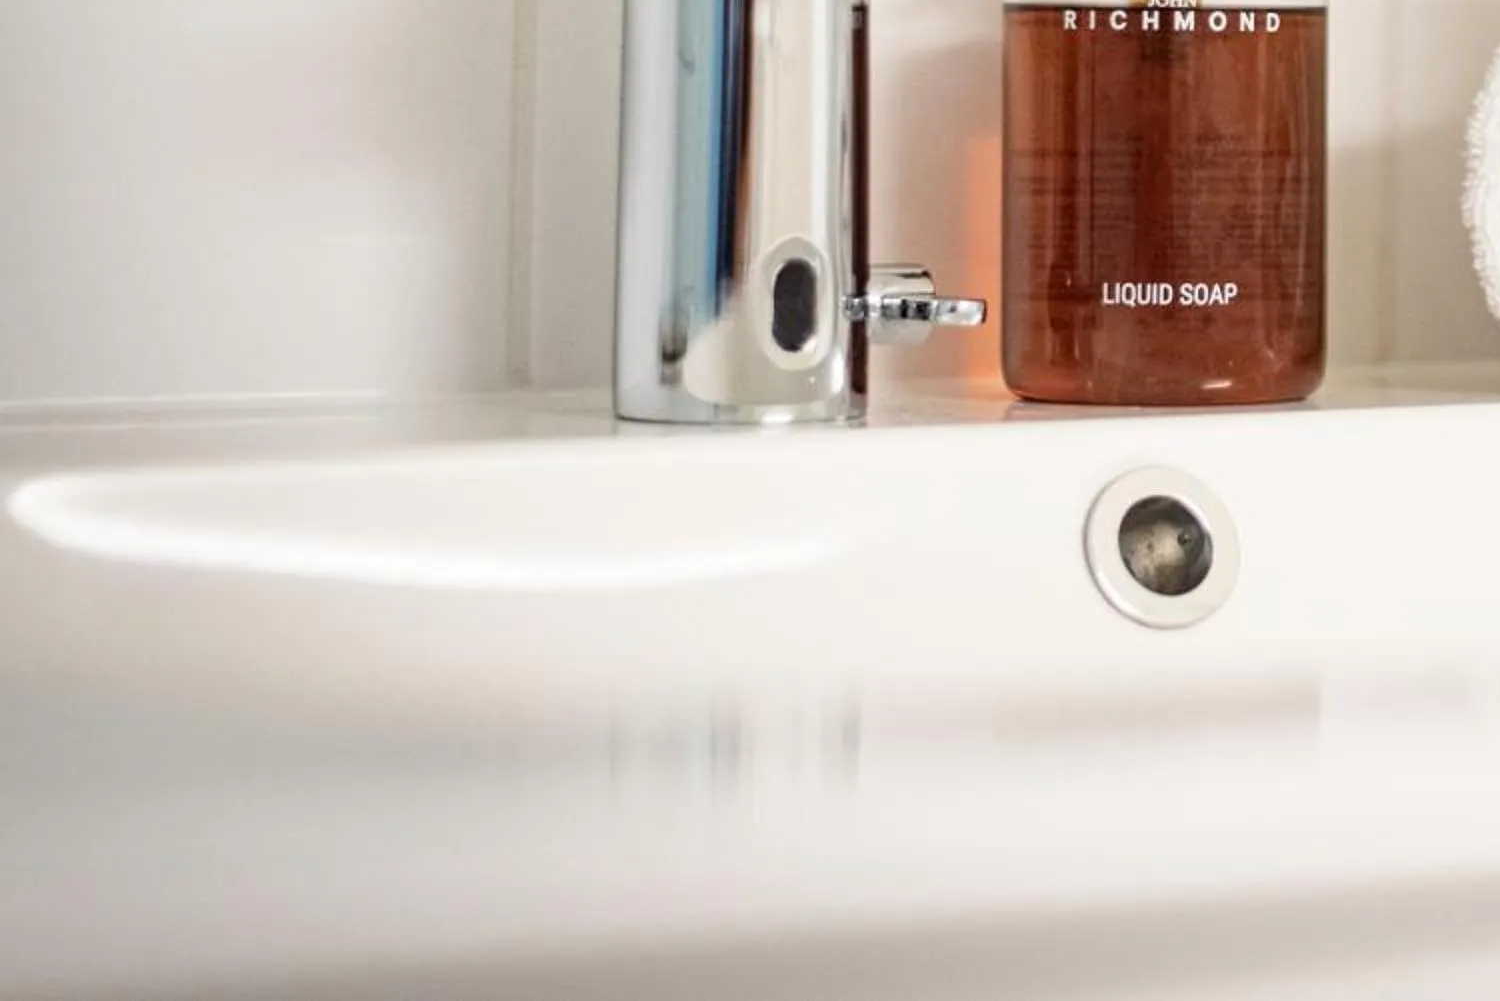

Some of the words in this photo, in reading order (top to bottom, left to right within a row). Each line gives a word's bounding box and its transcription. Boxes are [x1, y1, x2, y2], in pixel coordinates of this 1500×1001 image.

[1063, 11, 1281, 32] RICHMOND
[1103, 282, 1173, 306] LIQUID
[1179, 283, 1238, 305] SOAP
